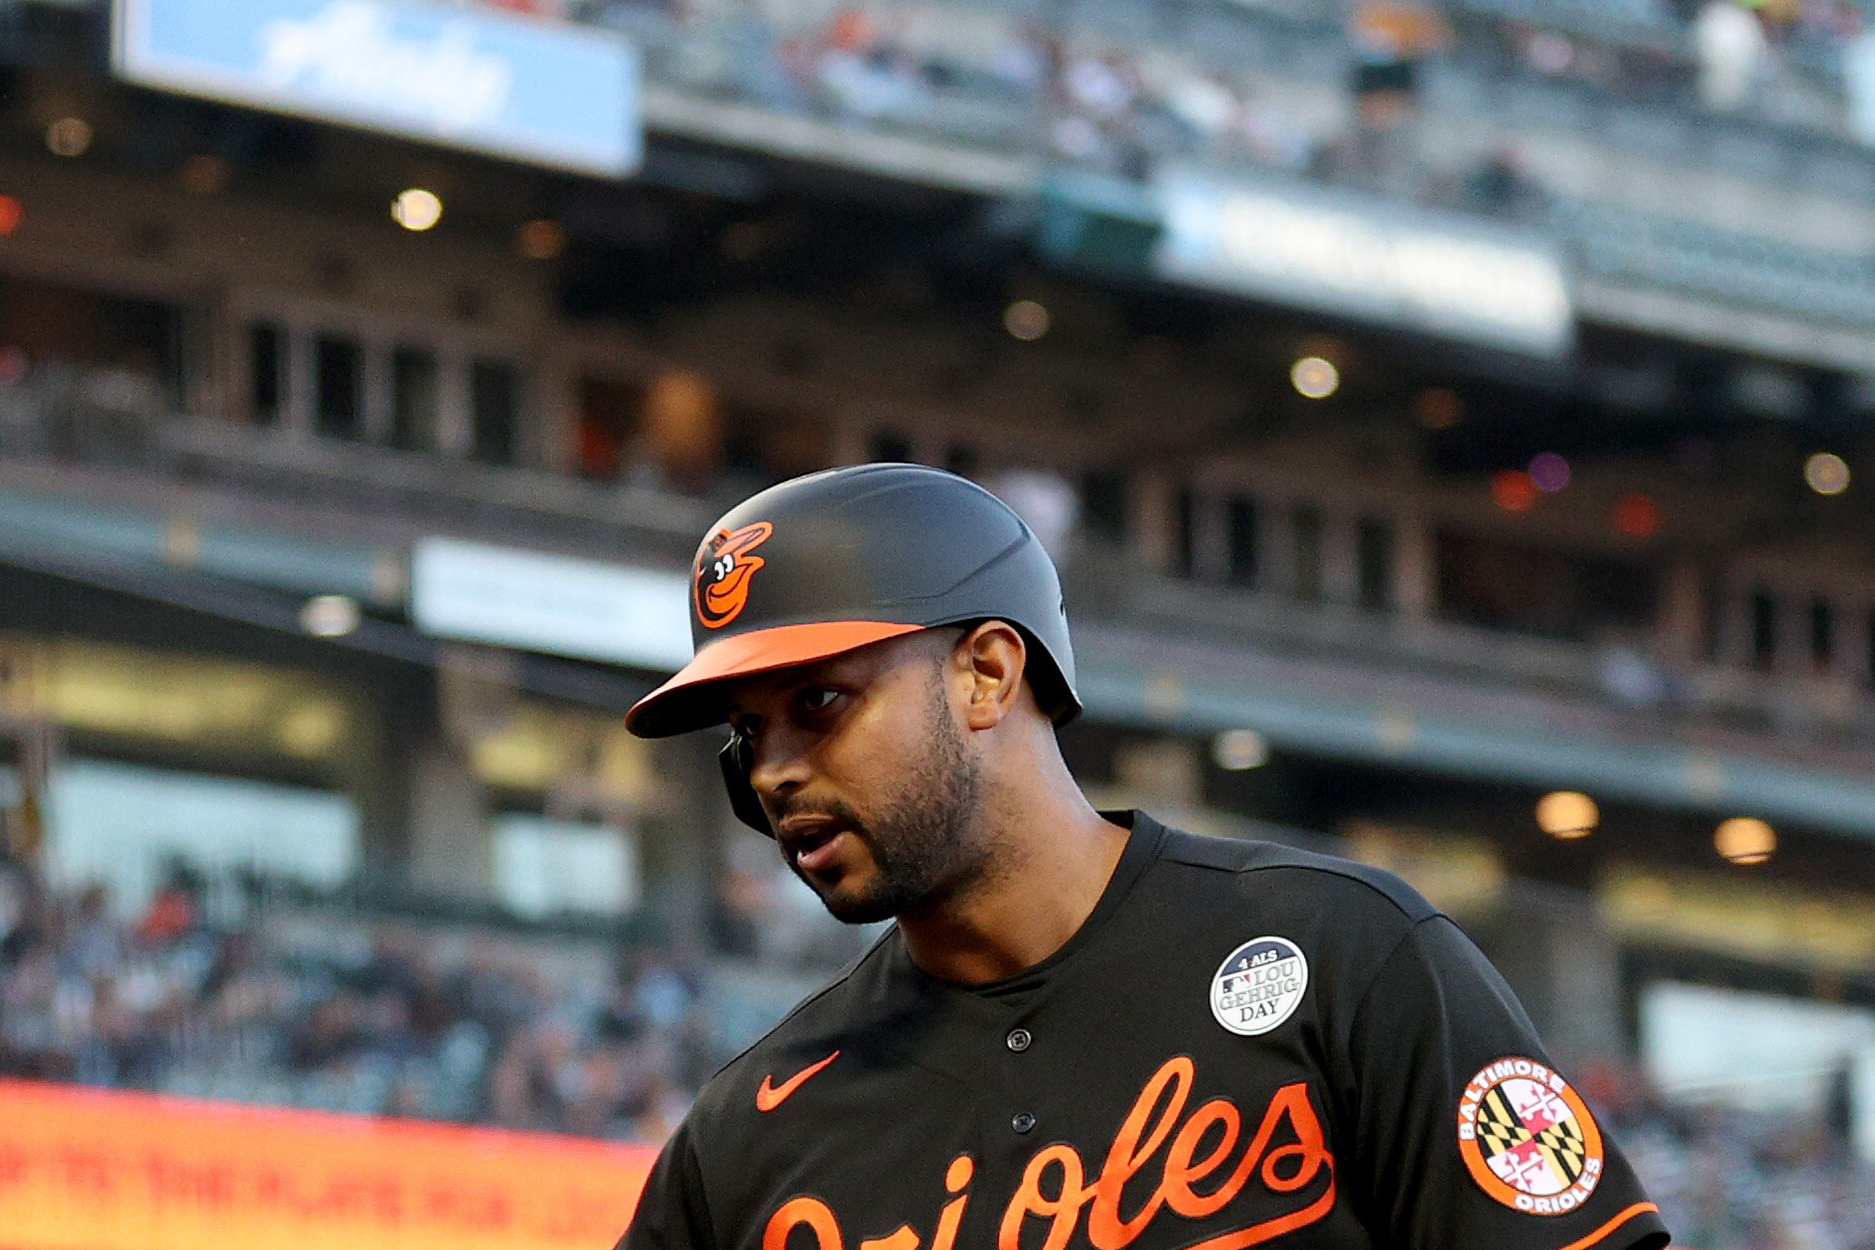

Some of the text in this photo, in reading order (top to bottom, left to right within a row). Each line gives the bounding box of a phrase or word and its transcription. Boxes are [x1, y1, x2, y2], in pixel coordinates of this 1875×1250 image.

[1254, 960, 1295, 986] LOU
[1219, 978, 1300, 1011] GEHRIG
[1239, 998, 1281, 1023] DAY
[1458, 1060, 1567, 1141] BALTIMORE
[1514, 1157, 1602, 1213] ORIOLES
